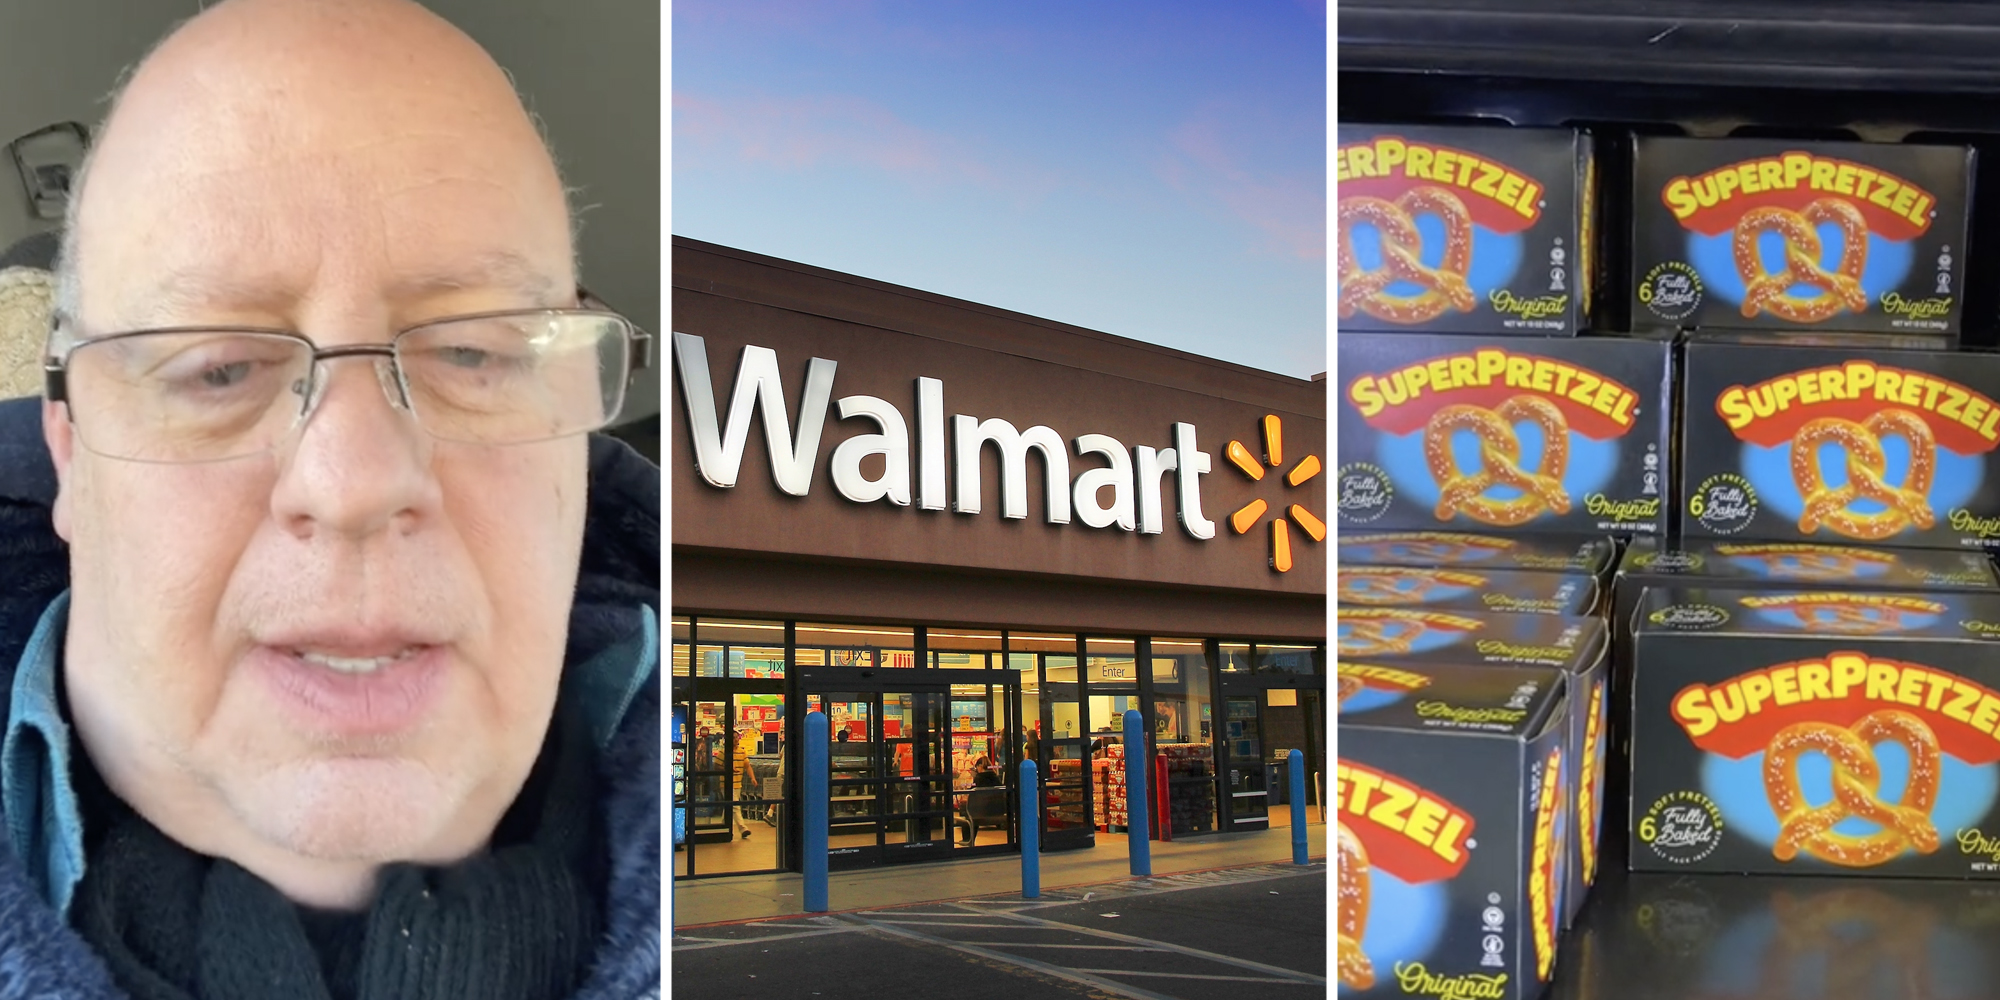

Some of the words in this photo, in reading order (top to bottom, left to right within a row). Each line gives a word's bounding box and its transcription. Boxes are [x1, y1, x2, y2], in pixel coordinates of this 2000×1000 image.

[1639, 282, 1652, 302] 6
[1656, 274, 1690, 293] Fully
[1489, 288, 1568, 319] Original
[1651, 287, 1696, 306] Baked
[1881, 291, 1952, 319] Original
[673, 332, 1216, 540] Walmart
[1343, 475, 1379, 494] Fully
[1338, 489, 1384, 509] Baked
[1584, 492, 1660, 521] Original
[1690, 495, 1704, 516] 6
[1709, 486, 1744, 507] Fully
[1702, 501, 1750, 521] Baked
[1102, 666, 1125, 677] Enter
[1677, 656, 2000, 741] SUPERPRETZE
[1416, 700, 1528, 723] Original
[1640, 816, 1656, 841] 6
[1649, 792, 1675, 815] SOFT
[1679, 791, 1722, 828] PRETZELS
[1662, 806, 1707, 829] Fully
[1654, 823, 1712, 848] Baked
[1394, 960, 1508, 1000] Original
